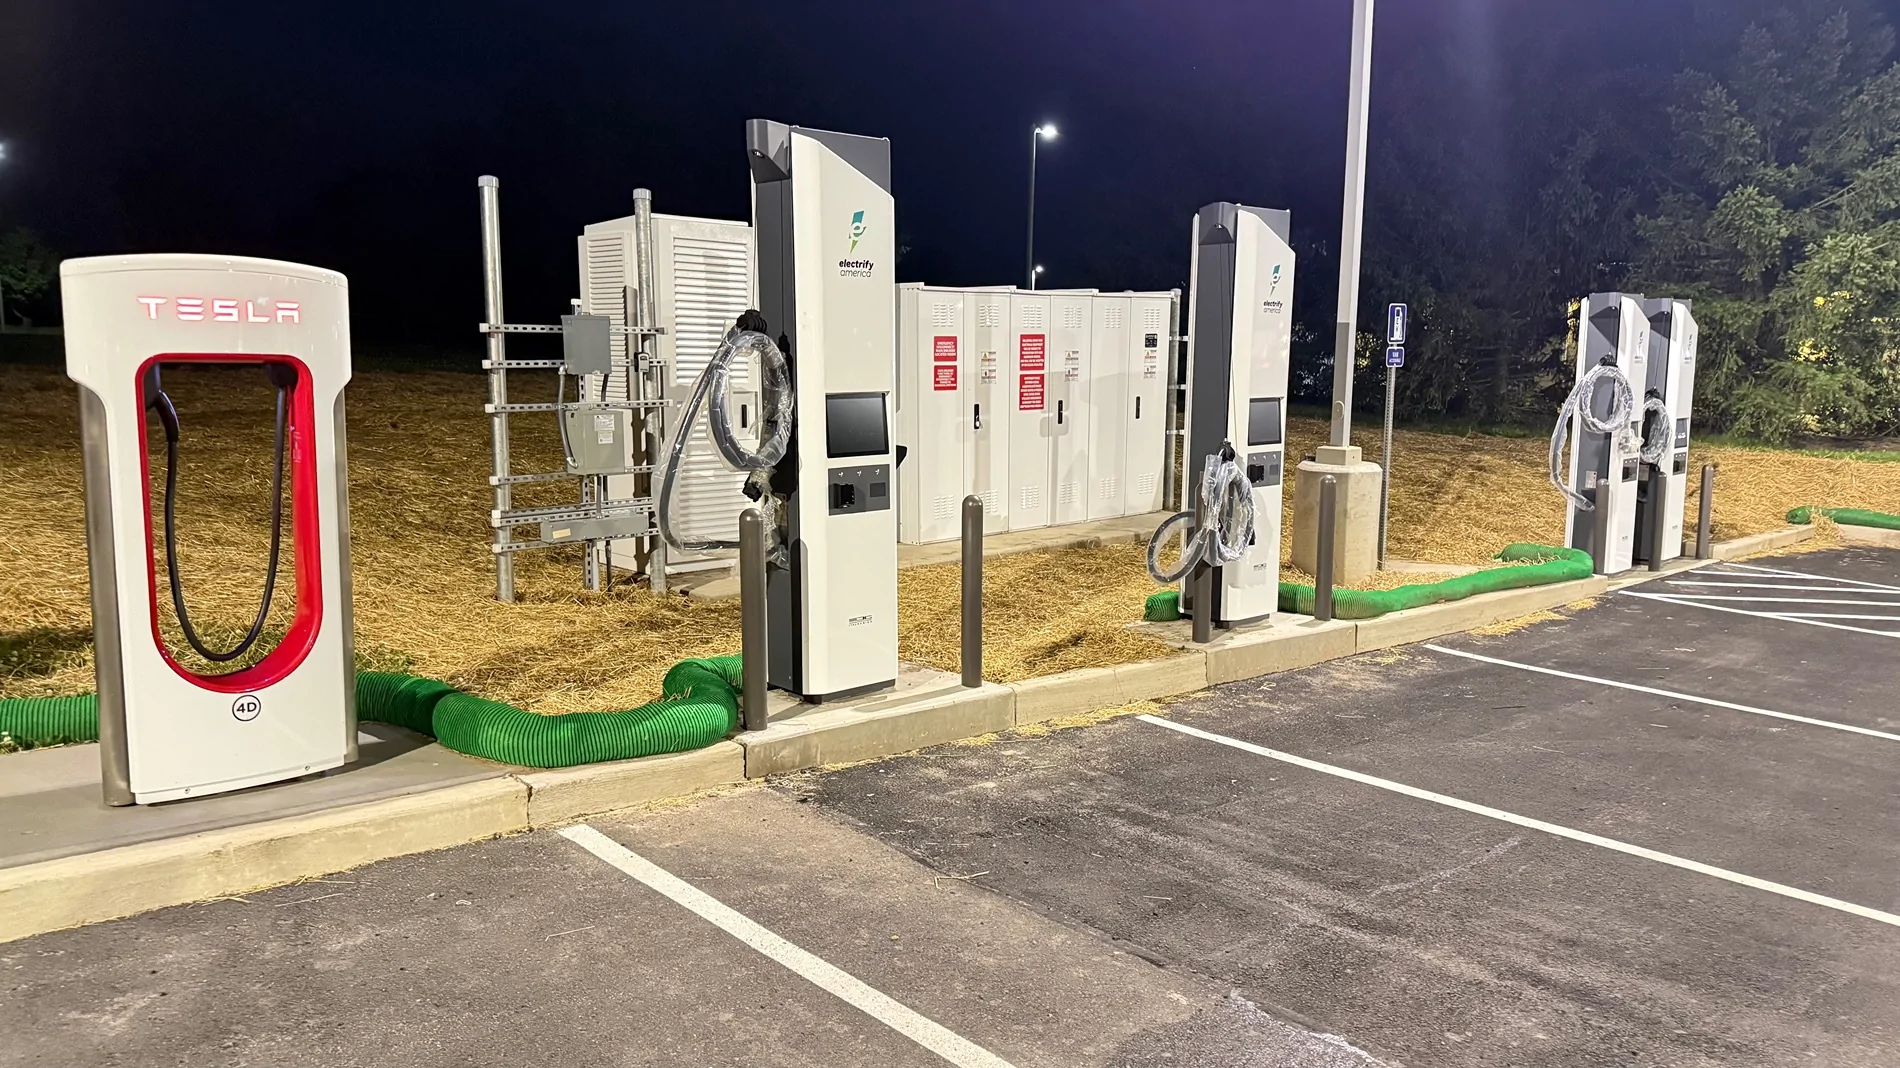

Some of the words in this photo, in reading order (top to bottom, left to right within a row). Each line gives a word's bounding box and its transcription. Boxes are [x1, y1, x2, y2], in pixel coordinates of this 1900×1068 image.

[839, 259, 874, 271] electrify
[840, 269, 872, 278] america
[136, 296, 300, 324] TESLA
[236, 702, 257, 713] 4D
